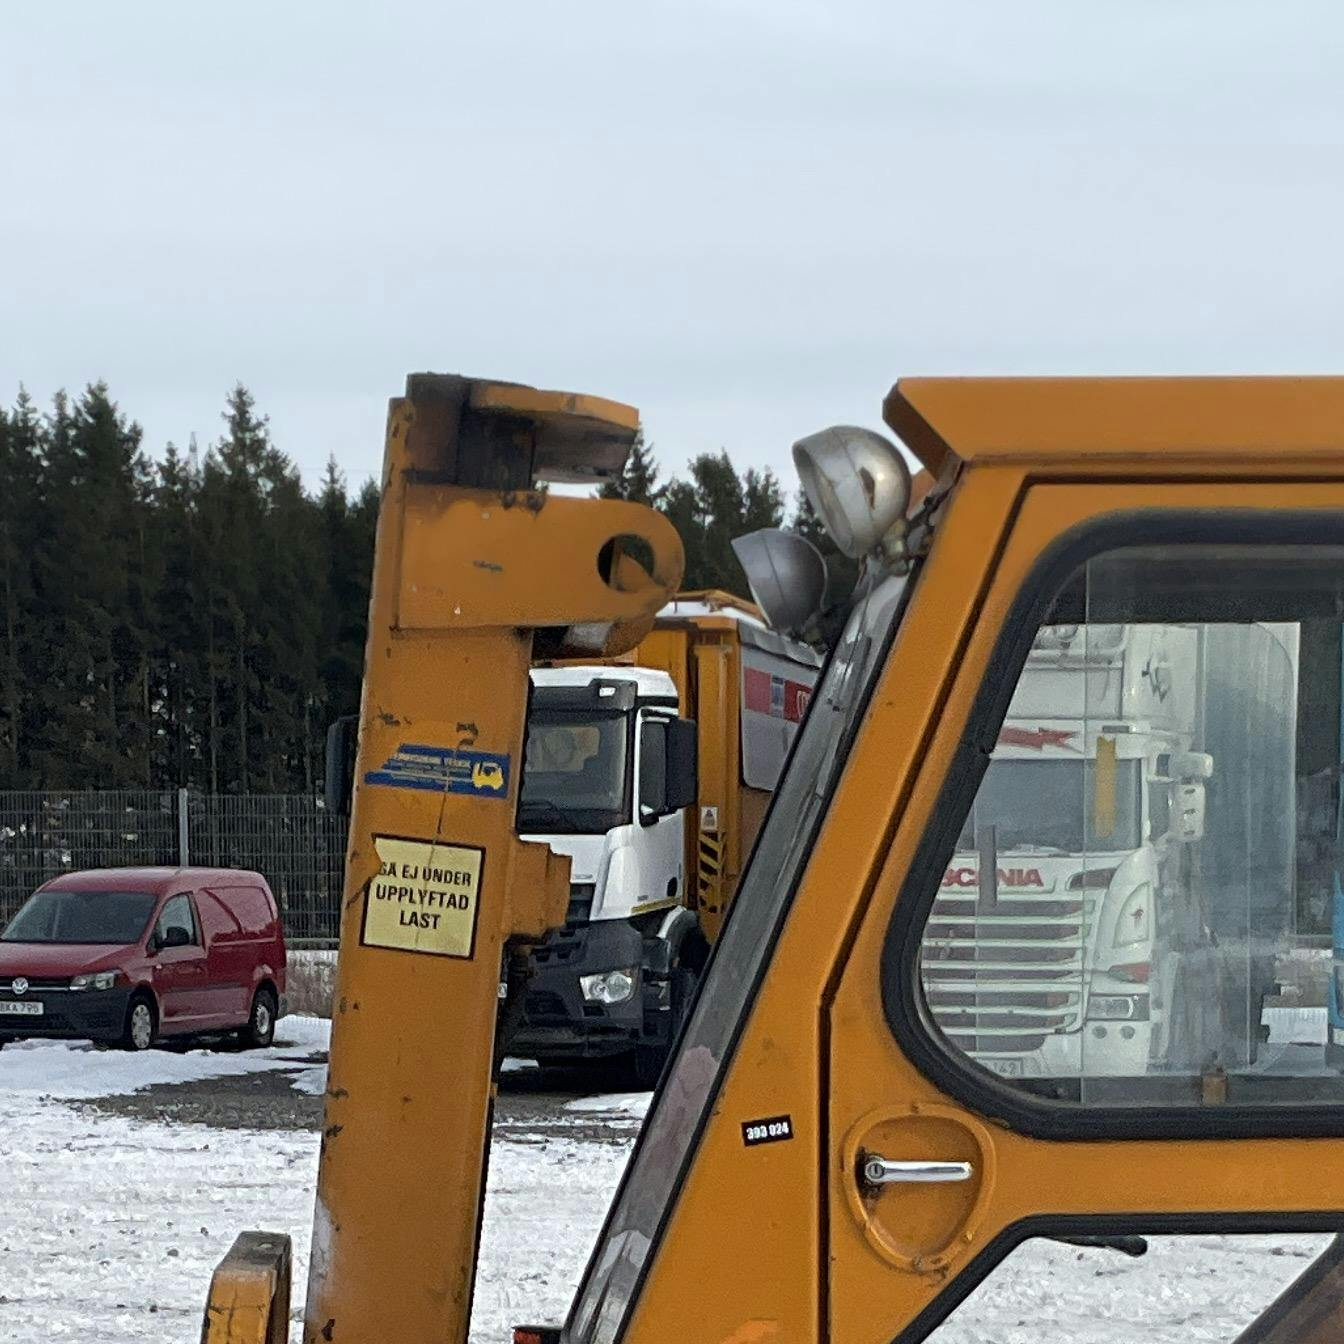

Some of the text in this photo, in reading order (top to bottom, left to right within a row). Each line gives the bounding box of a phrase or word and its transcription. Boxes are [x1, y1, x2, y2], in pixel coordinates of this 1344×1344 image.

[402, 864, 419, 880] EJ
[422, 866, 472, 888] UNDER
[375, 883, 470, 911] UPPLYFTAD
[399, 909, 441, 930] LAST
